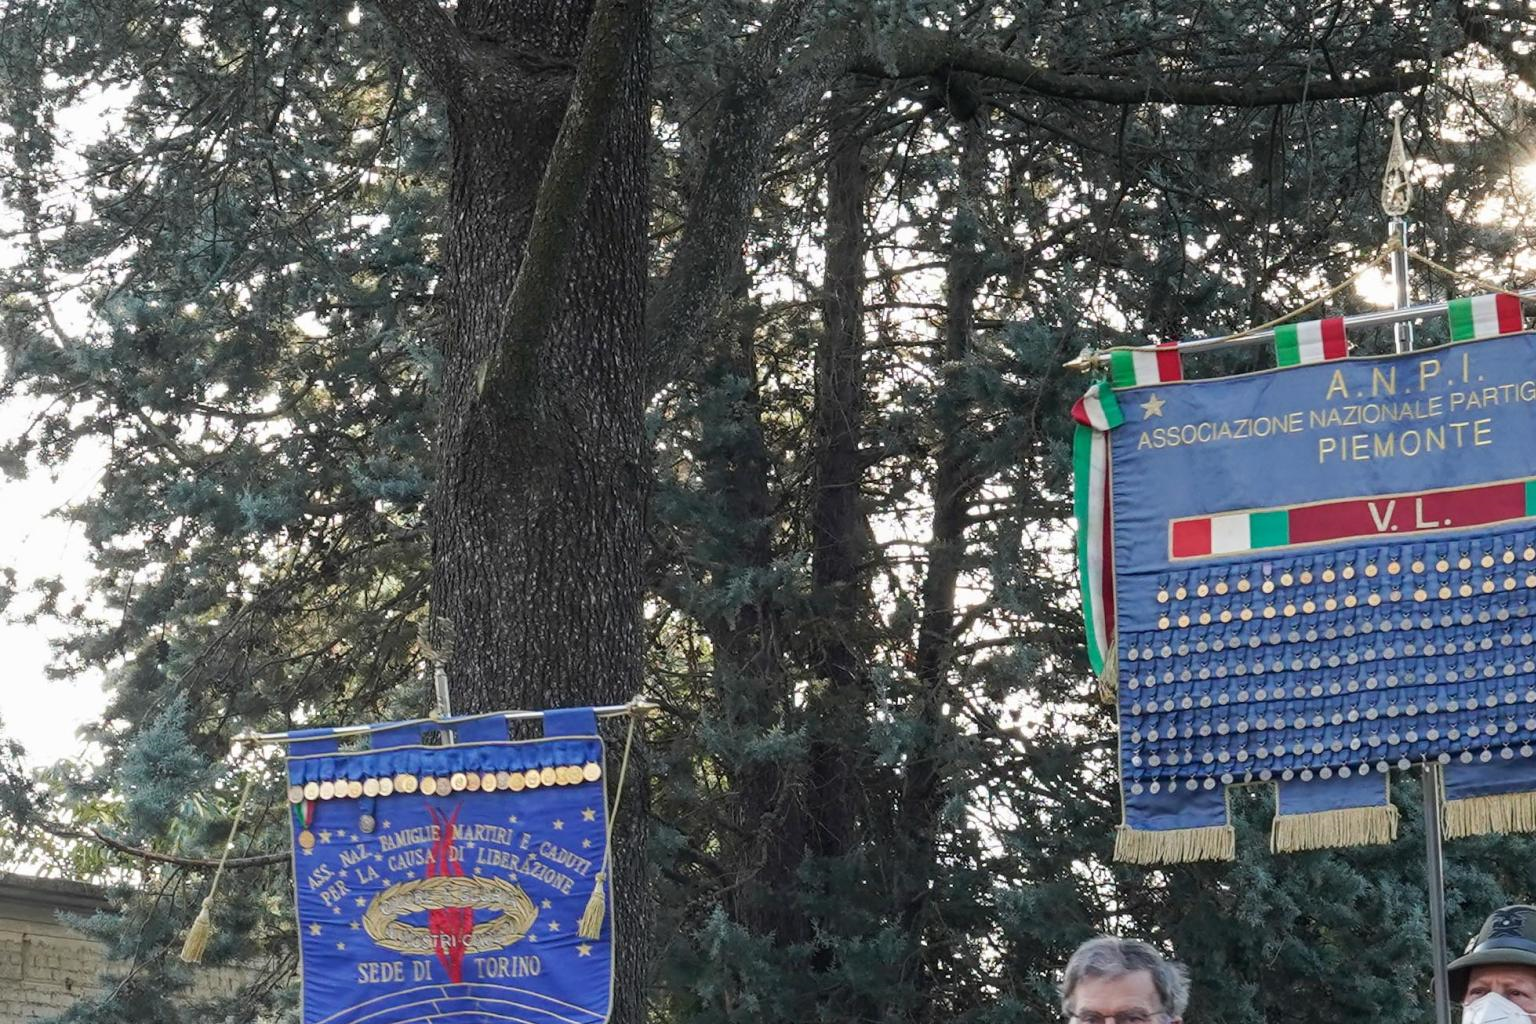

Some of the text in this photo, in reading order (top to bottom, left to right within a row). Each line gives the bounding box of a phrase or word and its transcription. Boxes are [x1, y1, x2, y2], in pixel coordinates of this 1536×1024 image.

[1137, 412, 1303, 450] ASSOCIAZIONE
[1309, 396, 1443, 429] NAZIONALE
[1319, 418, 1493, 464] PIEMONTE
[320, 845, 575, 907] PER LA CAUSA DI LIBERAZIONE
[379, 824, 441, 852] FAMIGLIE
[452, 823, 513, 846] MARTIRI
[520, 832, 532, 850] E
[540, 841, 593, 877] CADUTI
[358, 955, 542, 984] SEDE DI TORINO
